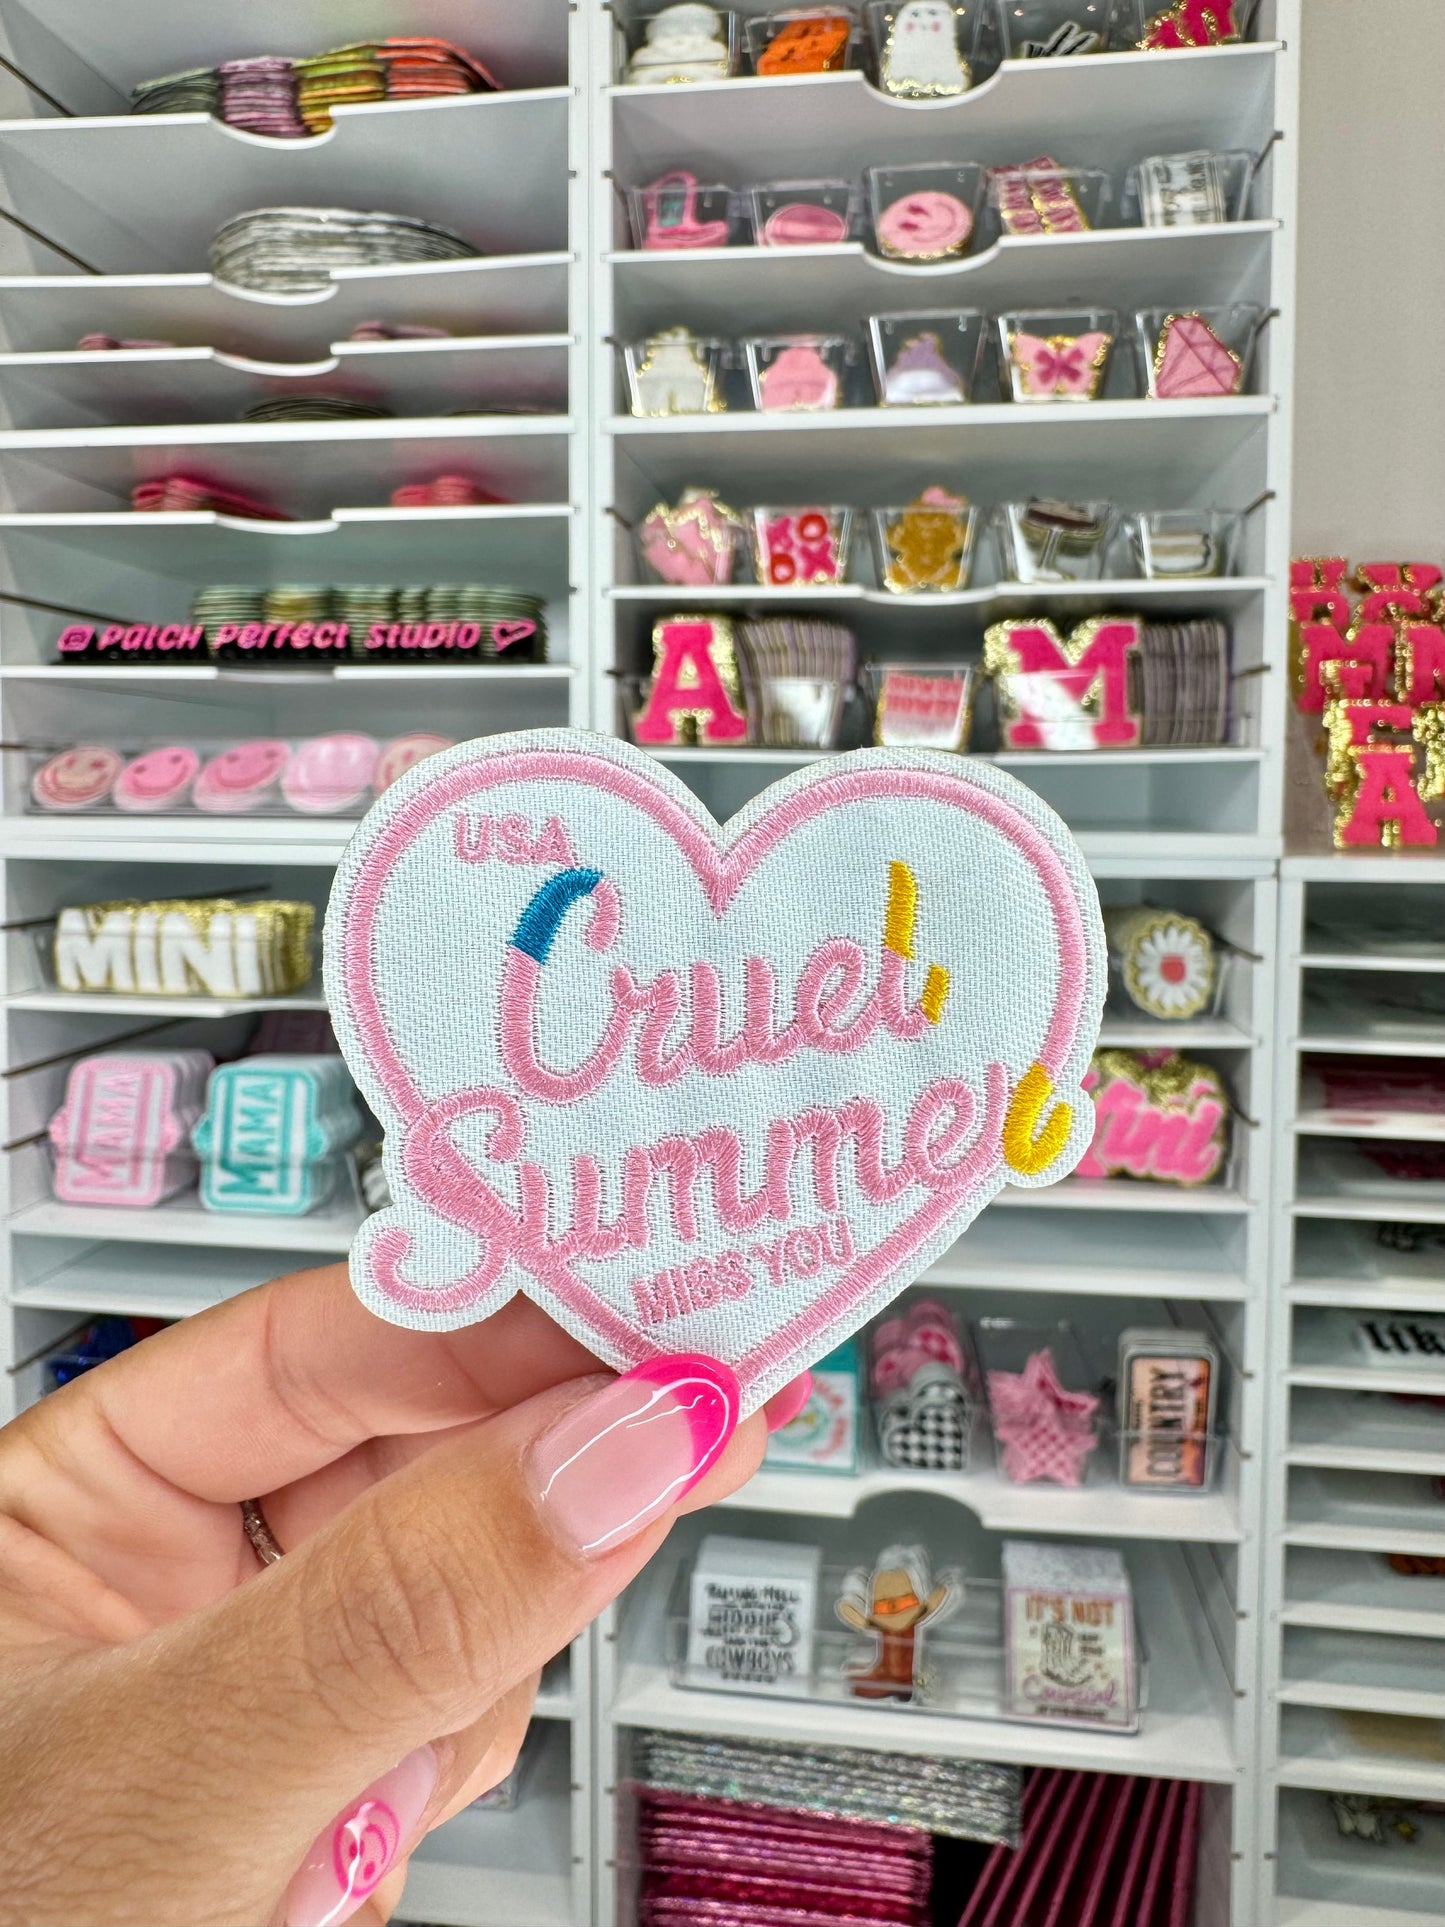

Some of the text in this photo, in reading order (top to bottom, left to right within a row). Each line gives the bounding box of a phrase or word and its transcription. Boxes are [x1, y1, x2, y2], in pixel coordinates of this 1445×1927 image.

[634, 621, 748, 744] A
[454, 811, 580, 867] USA
[56, 905, 264, 998] MINI
[498, 859, 951, 1108] Cruel
[68, 1072, 143, 1190] MAMA
[216, 1078, 283, 1196] MAMA
[366, 1060, 1076, 1314] Summer
[629, 1214, 860, 1328] MISS YOU
